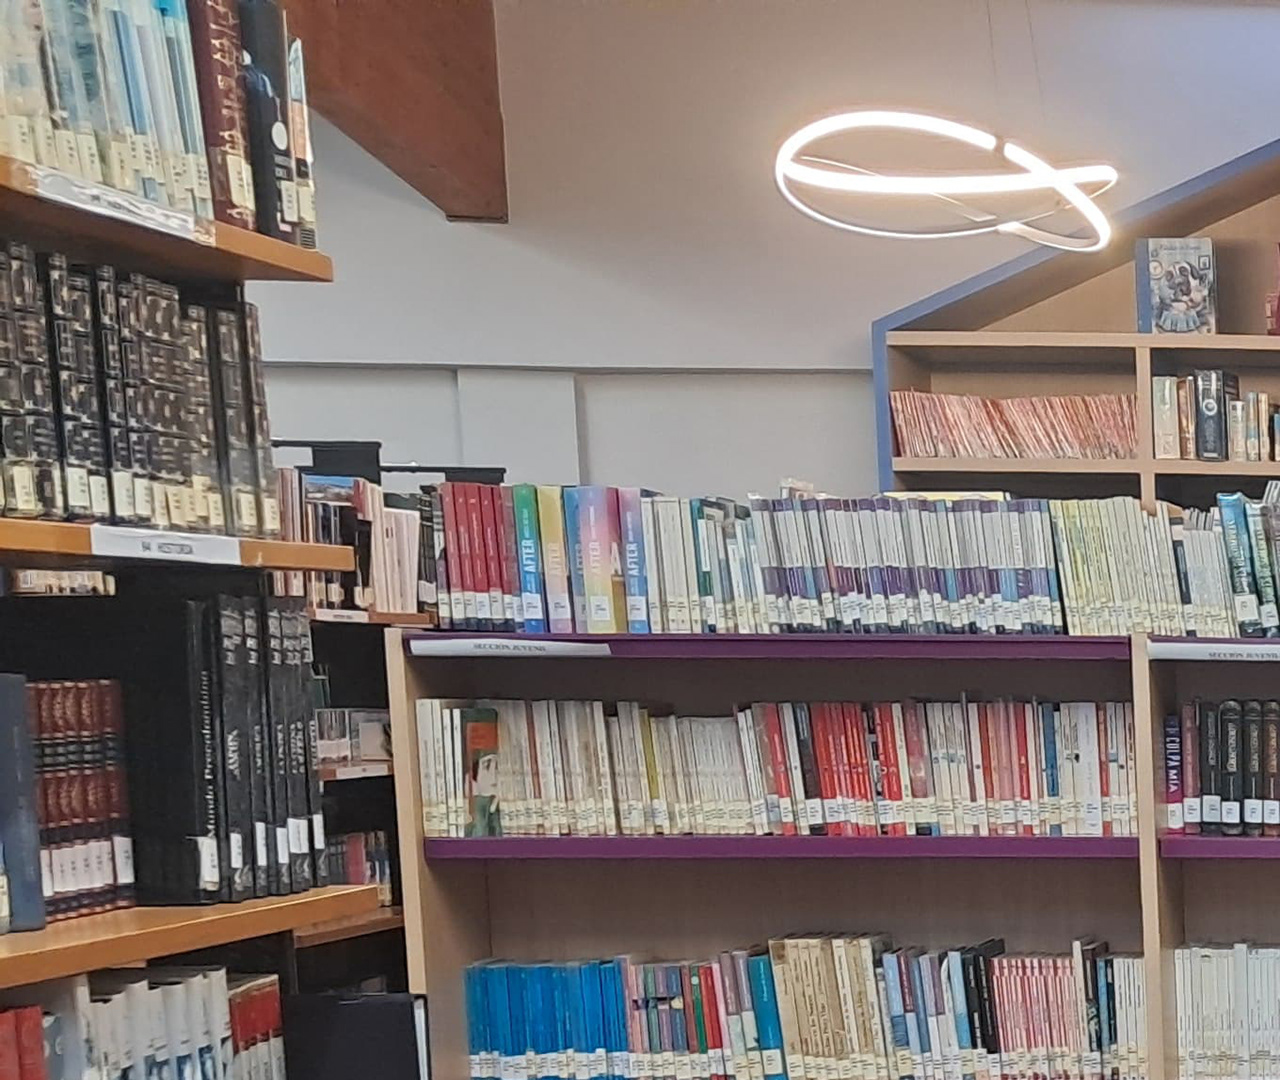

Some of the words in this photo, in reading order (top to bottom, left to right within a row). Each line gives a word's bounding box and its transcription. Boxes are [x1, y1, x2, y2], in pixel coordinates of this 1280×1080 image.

[523, 539, 536, 572] AFTER
[589, 541, 600, 575] AFTER
[628, 542, 639, 576] AFTER
[1168, 737, 1180, 767] CULPA
